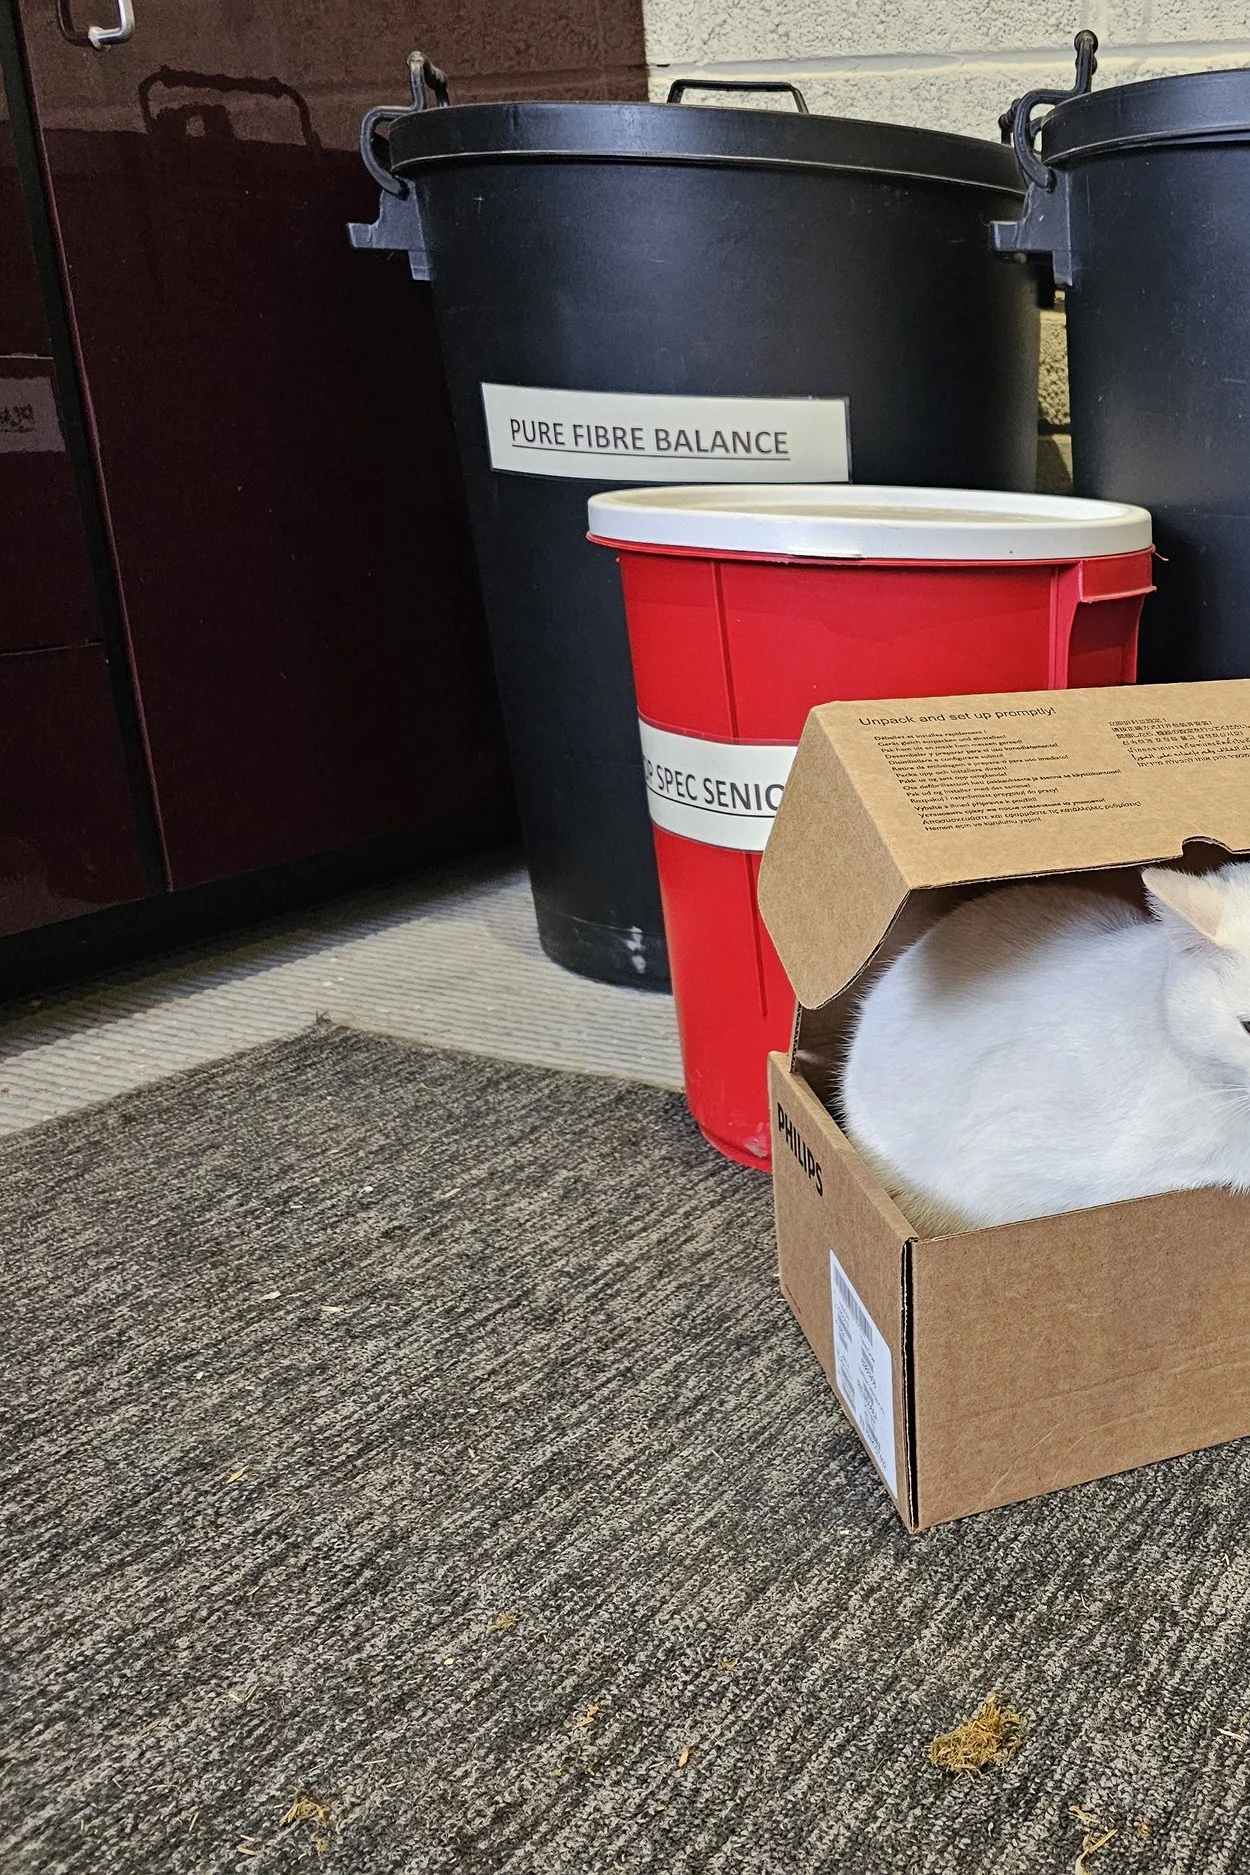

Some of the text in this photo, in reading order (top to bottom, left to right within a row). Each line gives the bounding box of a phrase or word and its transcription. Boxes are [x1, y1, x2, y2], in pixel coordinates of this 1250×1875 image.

[509, 418, 790, 456] PURE FIBRE BALANCE
[859, 707, 1057, 727] Unpack and set up promptly!
[656, 764, 698, 801] SPEC
[777, 1101, 823, 1197] PHILIPS
